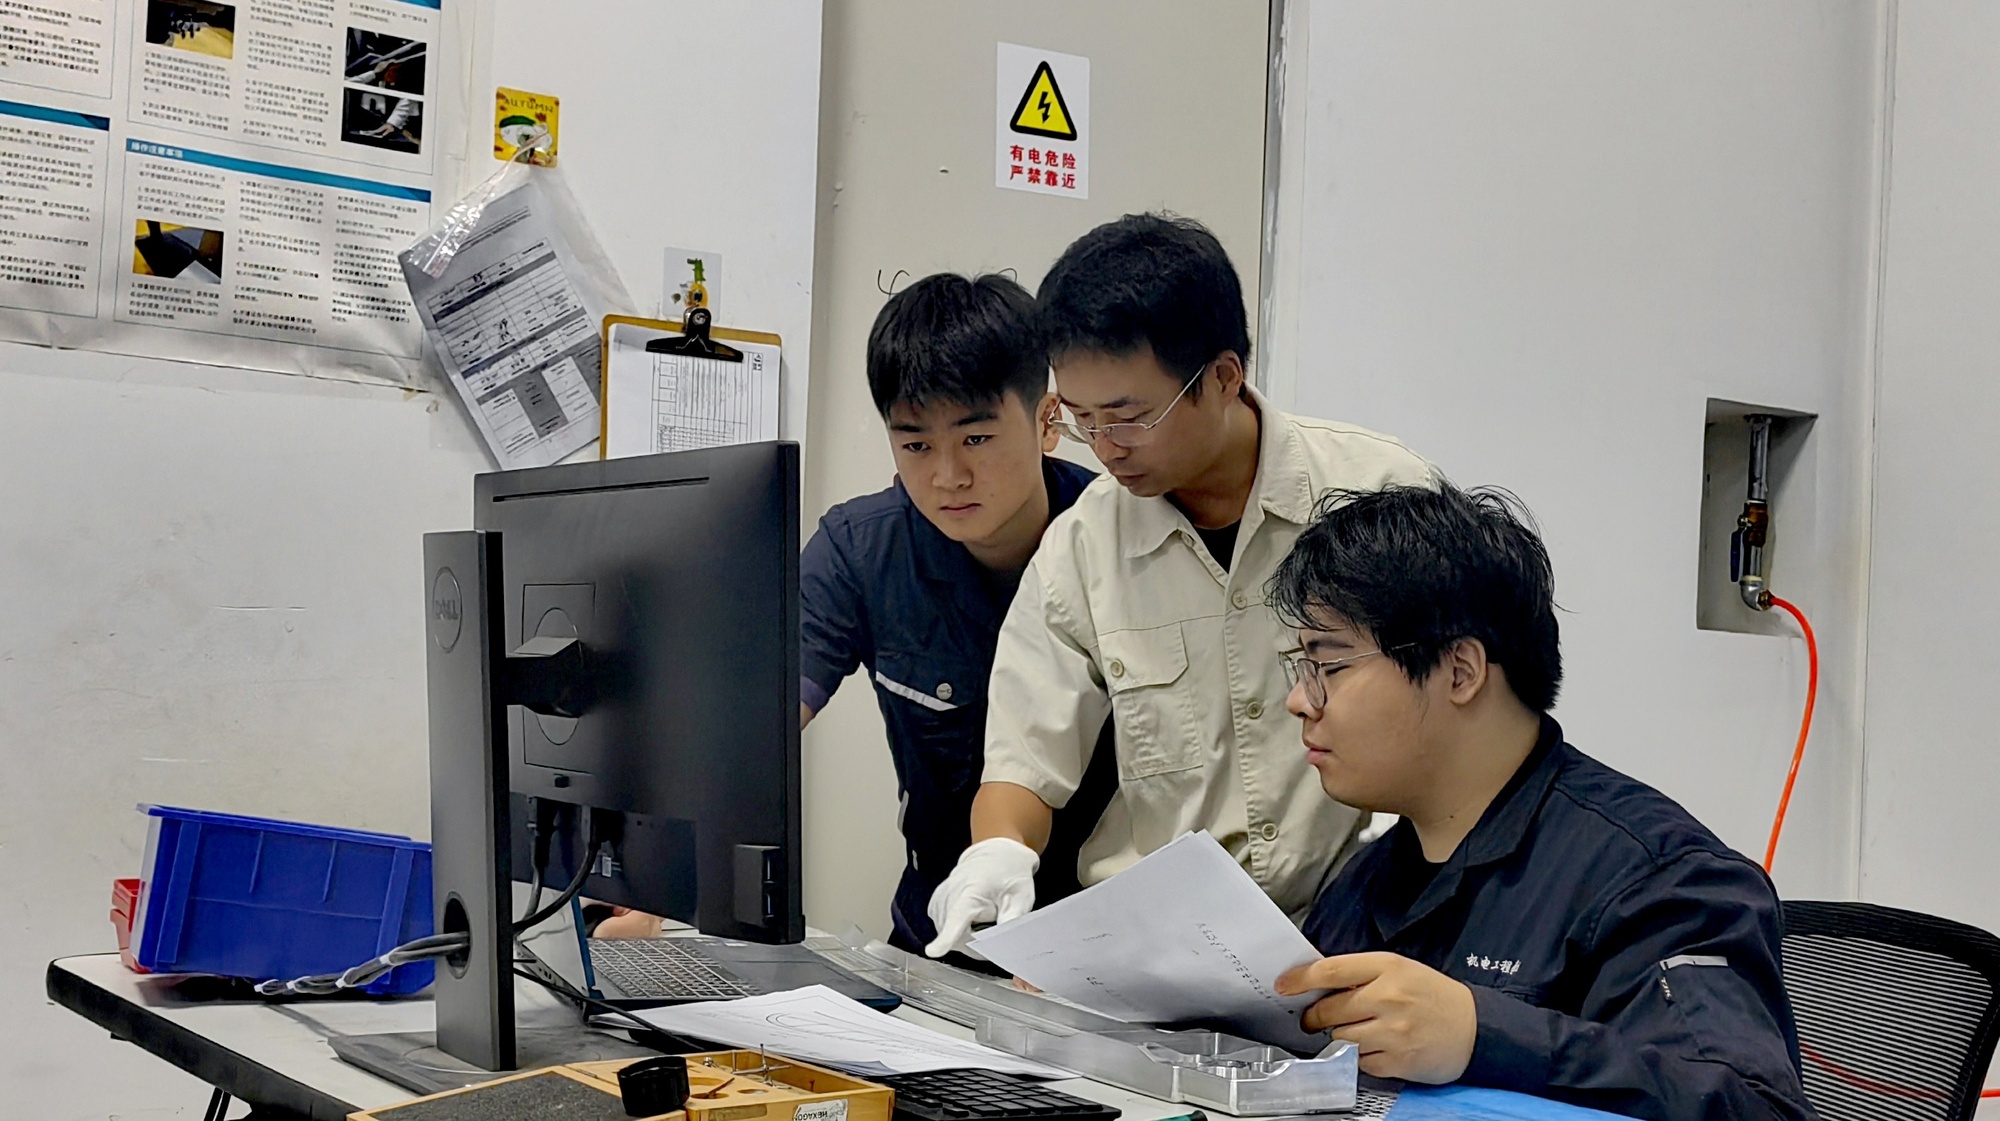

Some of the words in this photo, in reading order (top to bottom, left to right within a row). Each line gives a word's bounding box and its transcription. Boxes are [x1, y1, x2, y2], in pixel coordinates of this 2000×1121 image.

[505, 98, 554, 113] AUTUMN
[1010, 145, 1076, 169] 有电危险
[1010, 165, 1076, 189] 严禁靠近
[794, 1111, 828, 1121] HEXAGO
